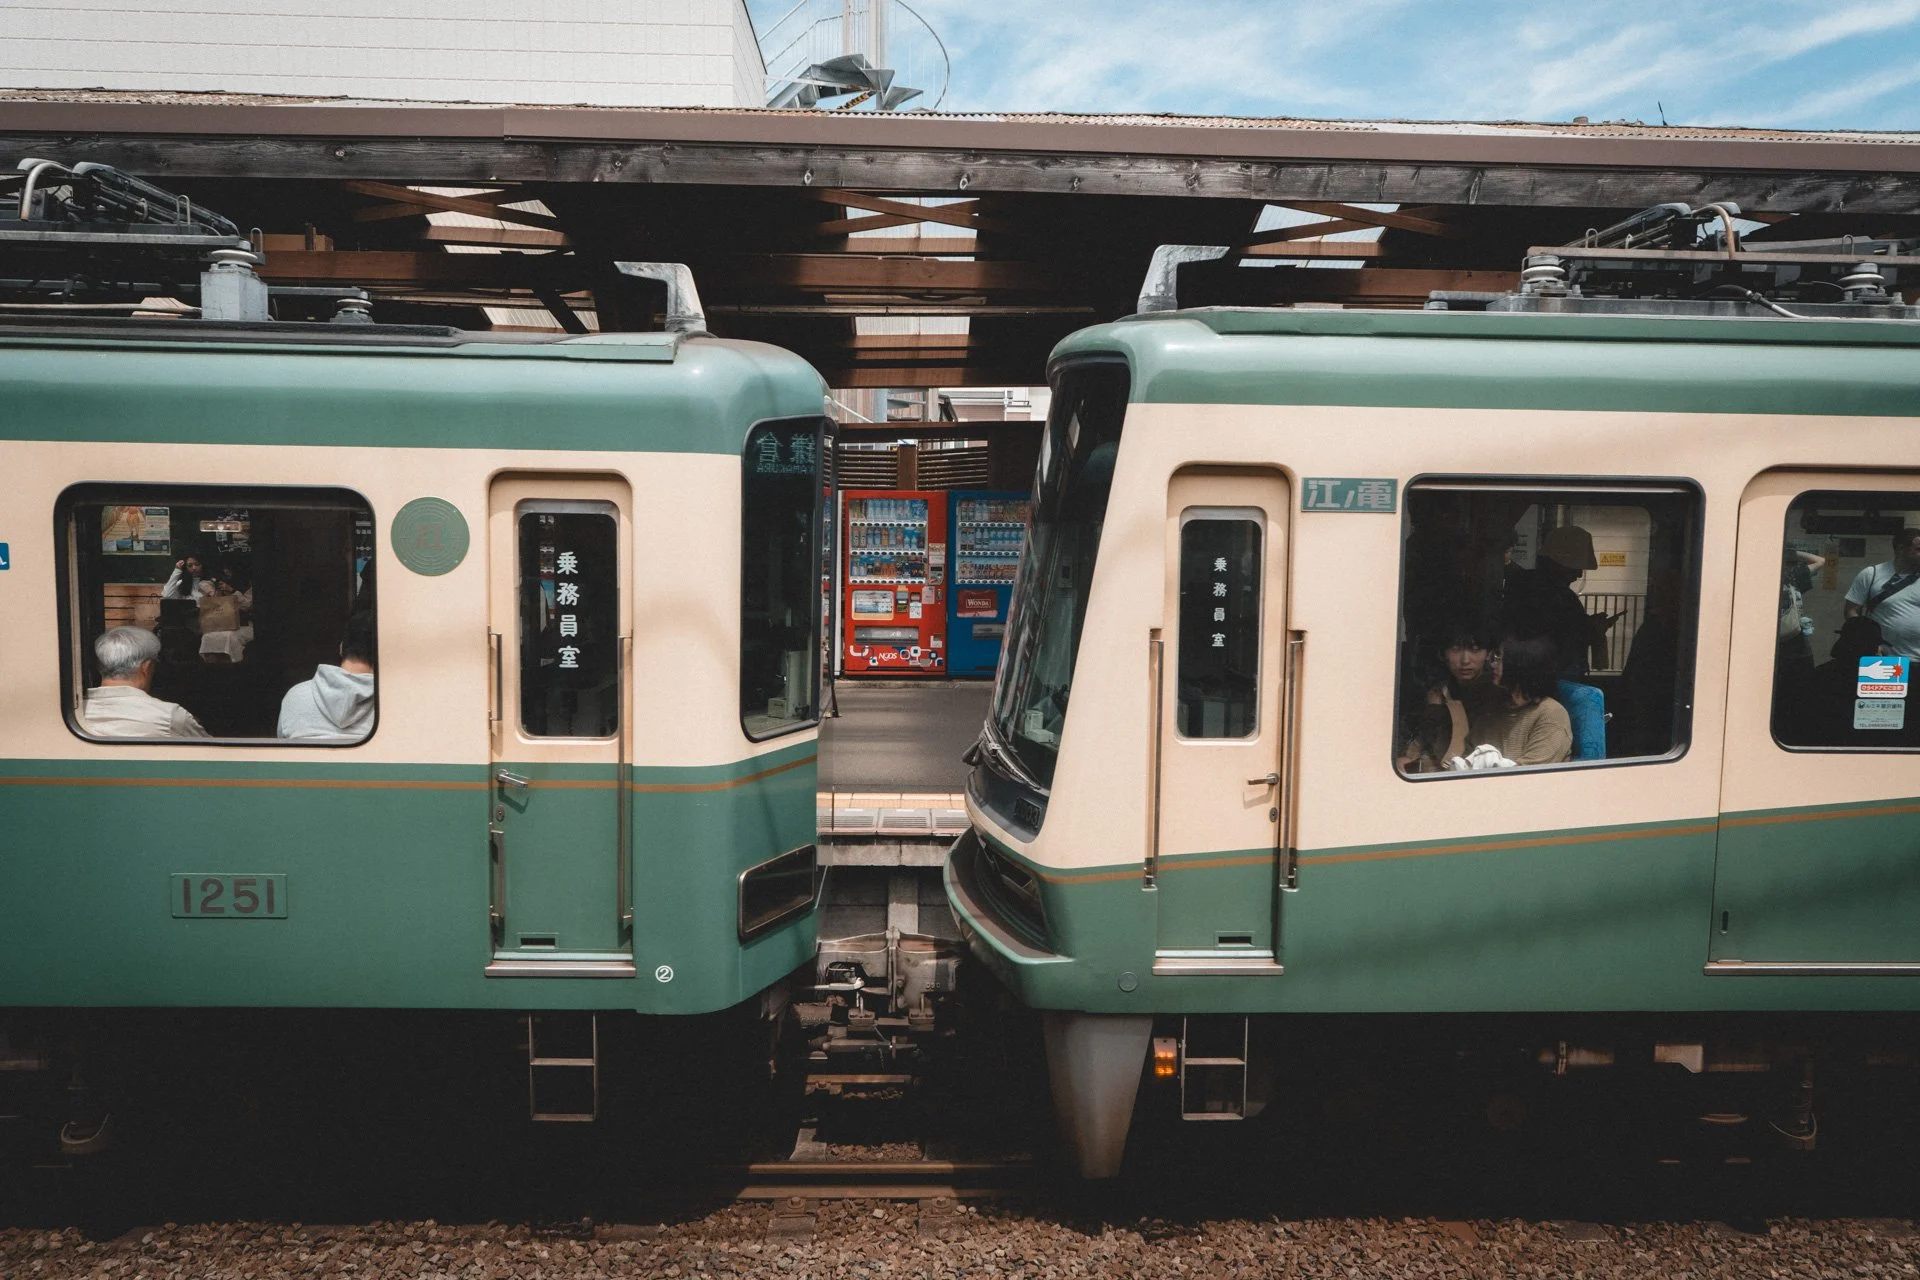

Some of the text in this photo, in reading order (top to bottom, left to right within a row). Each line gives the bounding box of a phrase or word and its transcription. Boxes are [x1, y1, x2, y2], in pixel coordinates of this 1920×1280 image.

[1308, 480, 1391, 508] 江ノ電
[557, 551, 580, 668] 乗務員室
[1212, 557, 1227, 647] 乗務員室
[183, 878, 275, 914] 1251
